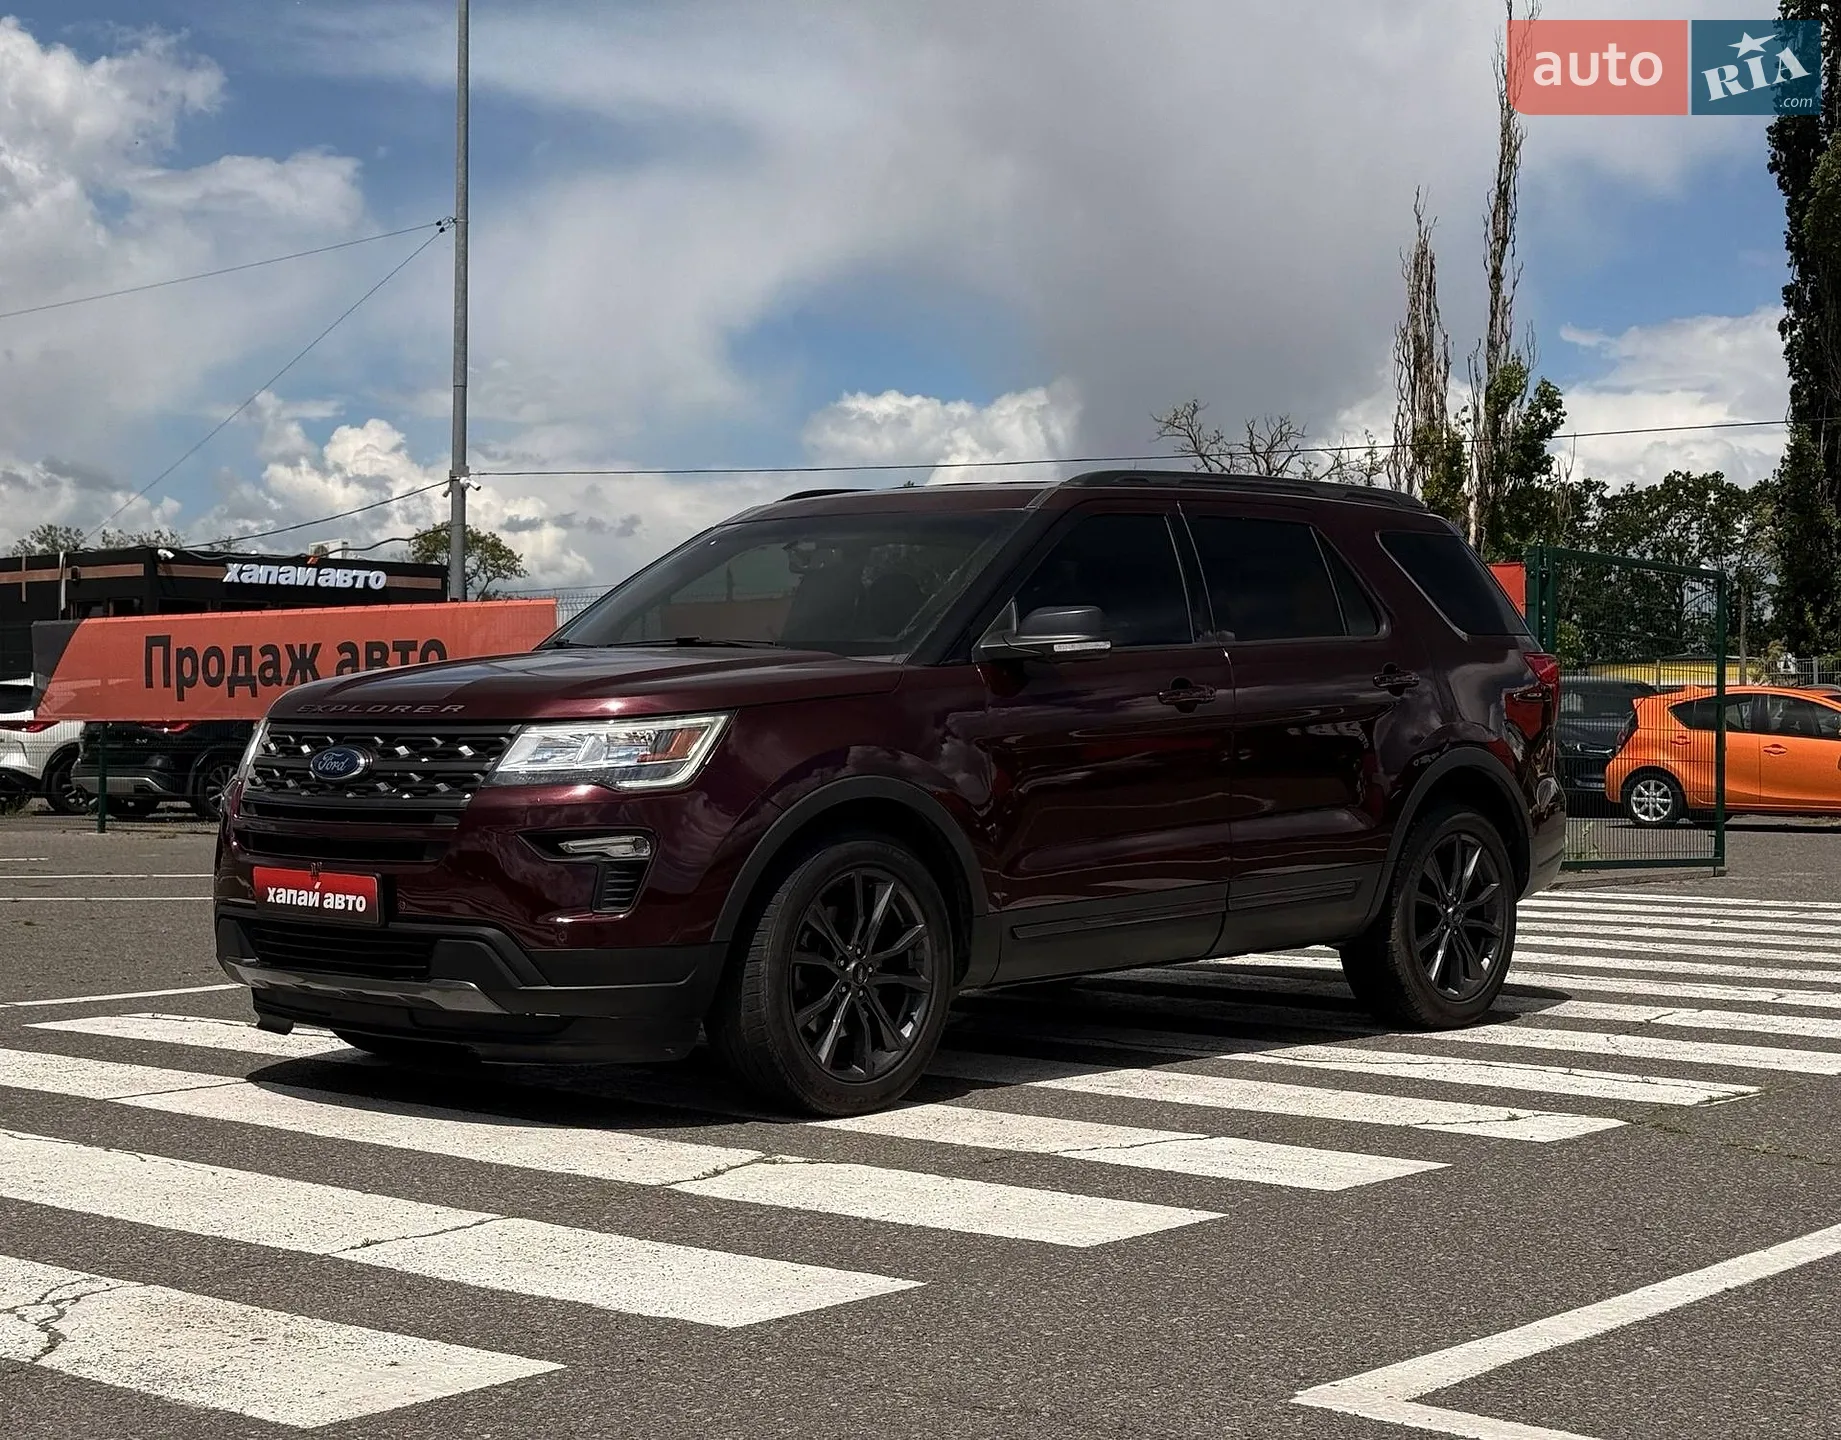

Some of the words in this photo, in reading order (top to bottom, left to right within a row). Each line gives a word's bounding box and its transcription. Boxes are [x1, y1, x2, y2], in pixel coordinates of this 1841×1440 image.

[144, 634, 322, 702] Продаж
[297, 704, 466, 714] EXPLORER
[317, 751, 350, 772] Ford
[267, 881, 321, 908] хапай
[323, 892, 367, 912] авто
